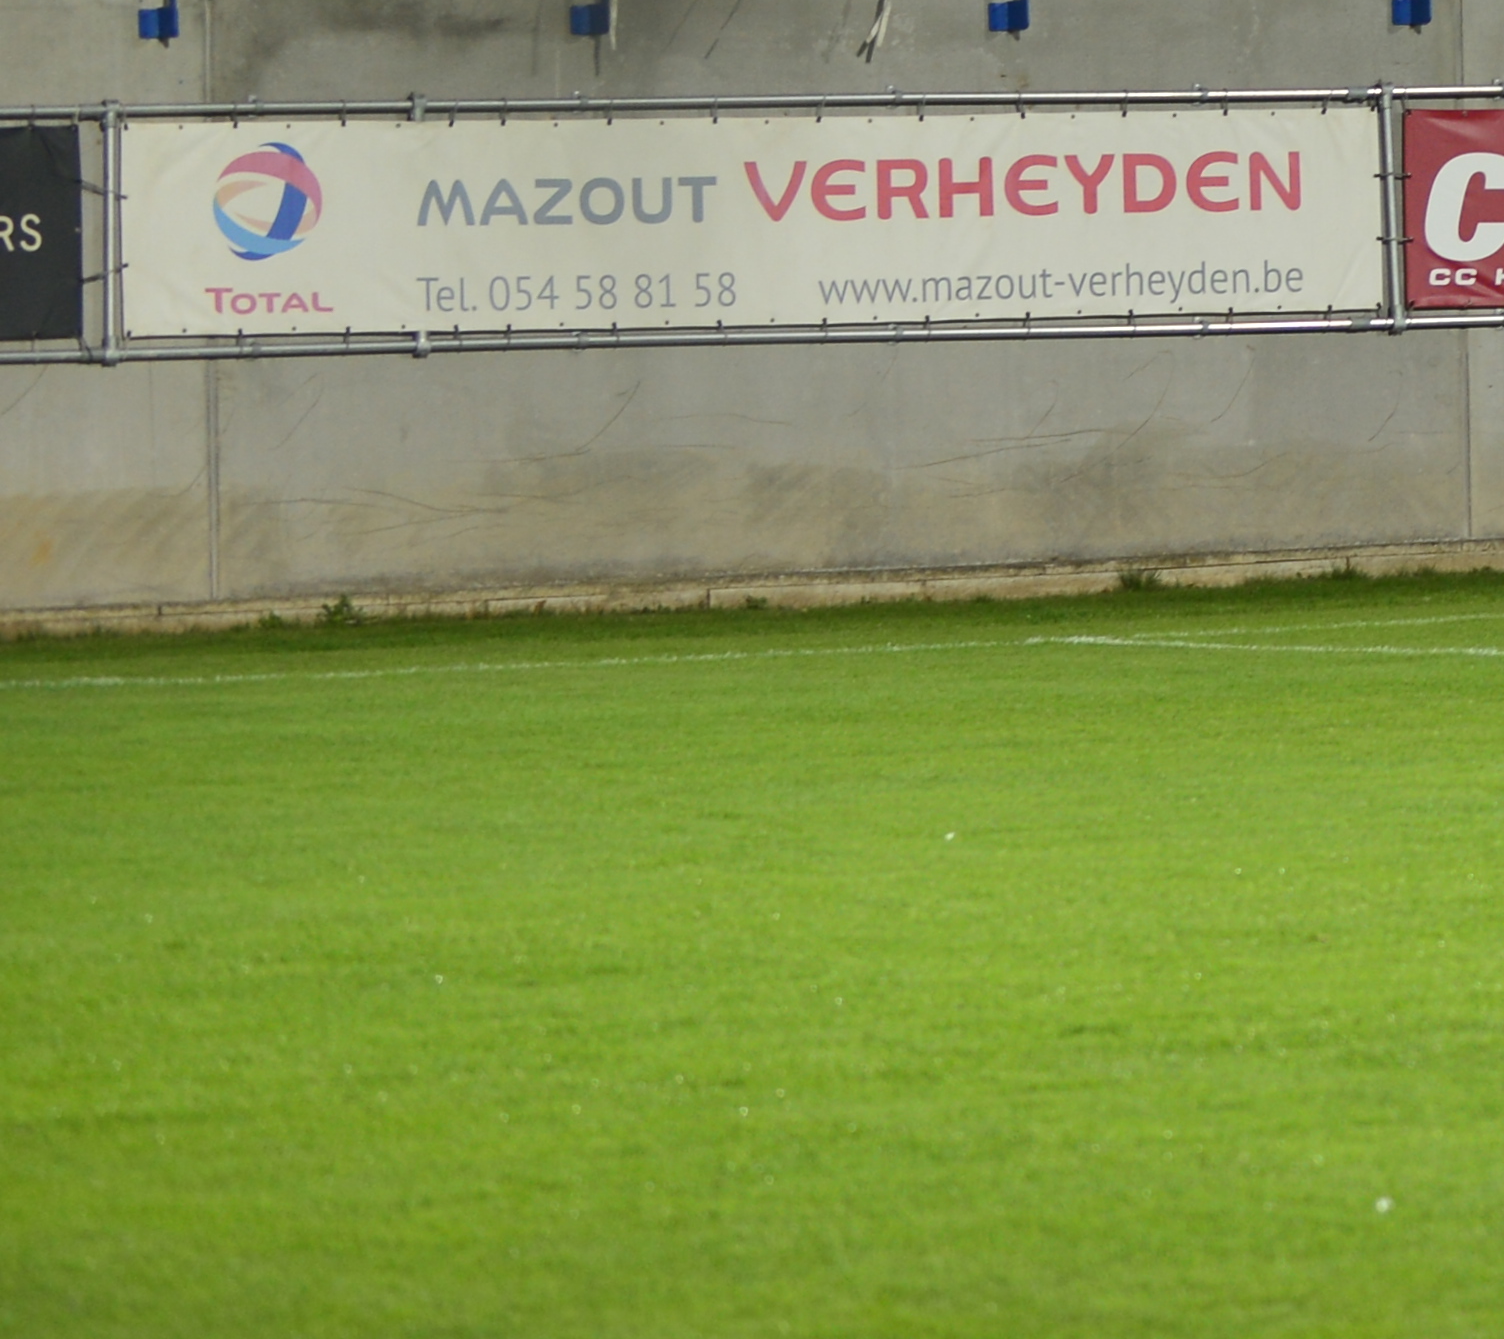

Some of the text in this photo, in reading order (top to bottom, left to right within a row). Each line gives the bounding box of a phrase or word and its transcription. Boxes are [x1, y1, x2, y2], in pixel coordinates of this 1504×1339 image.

[416, 150, 1302, 227] MAZOUT VERHEYDEN
[416, 259, 1304, 312] Tel. 054 58 81 58 www.mazout-verheyden.be
[1428, 268, 1479, 286] CC
